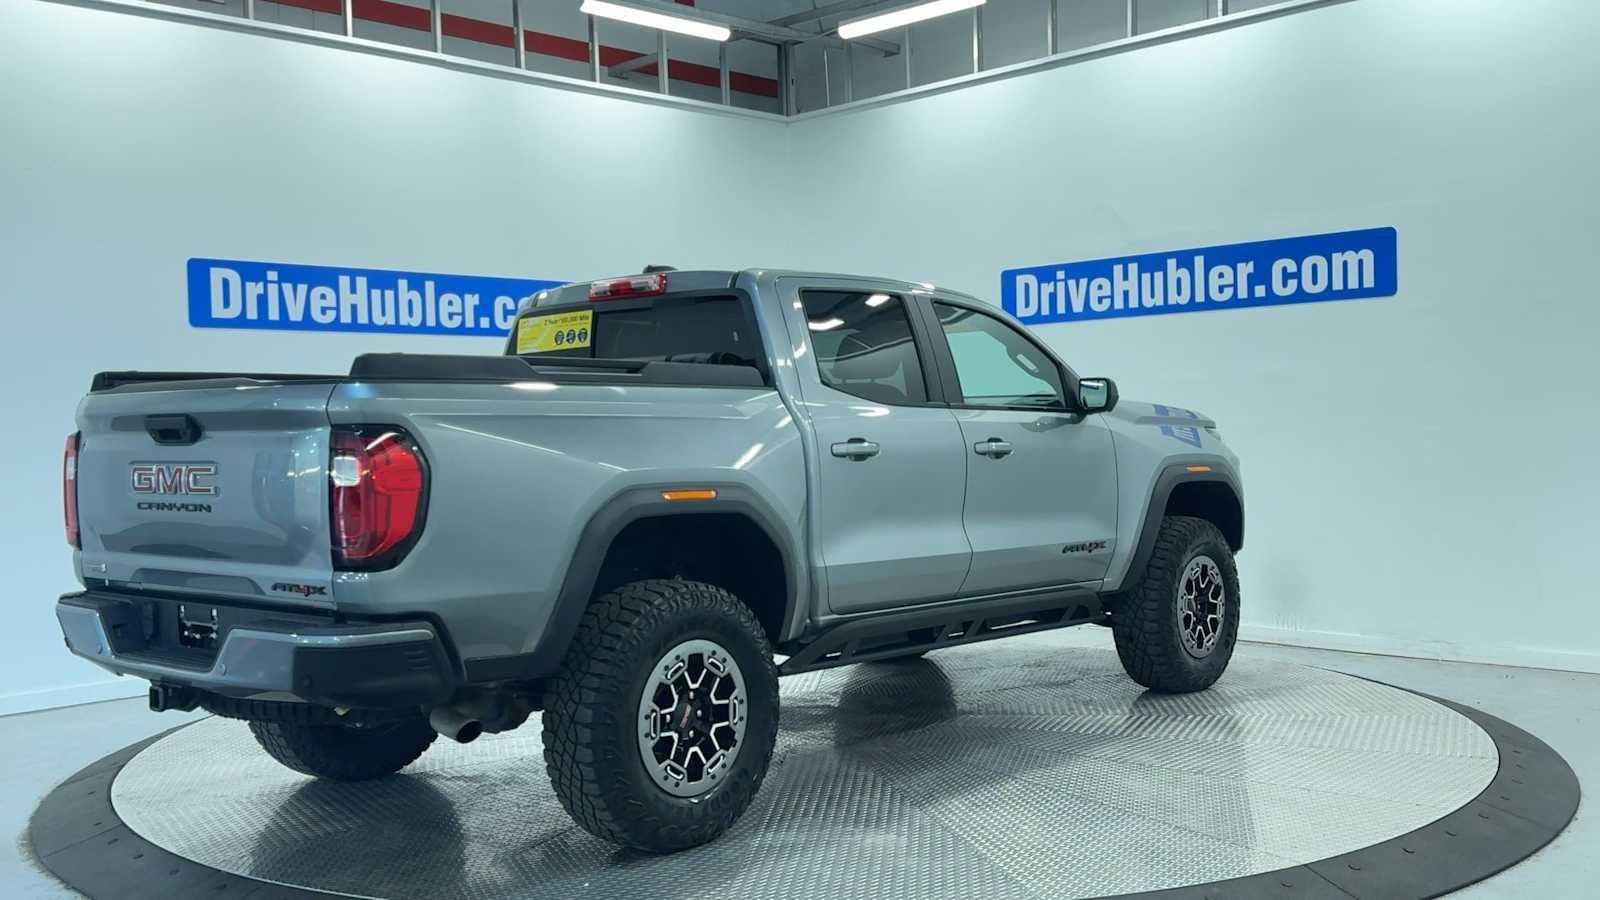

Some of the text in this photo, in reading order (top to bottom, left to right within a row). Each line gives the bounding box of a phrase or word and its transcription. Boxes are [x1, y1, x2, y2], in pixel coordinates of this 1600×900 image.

[209, 267, 529, 329] DriveHubler.c
[1015, 247, 1375, 318] DriveHubler.com
[131, 464, 215, 495] GMC
[137, 502, 212, 512] CANYON
